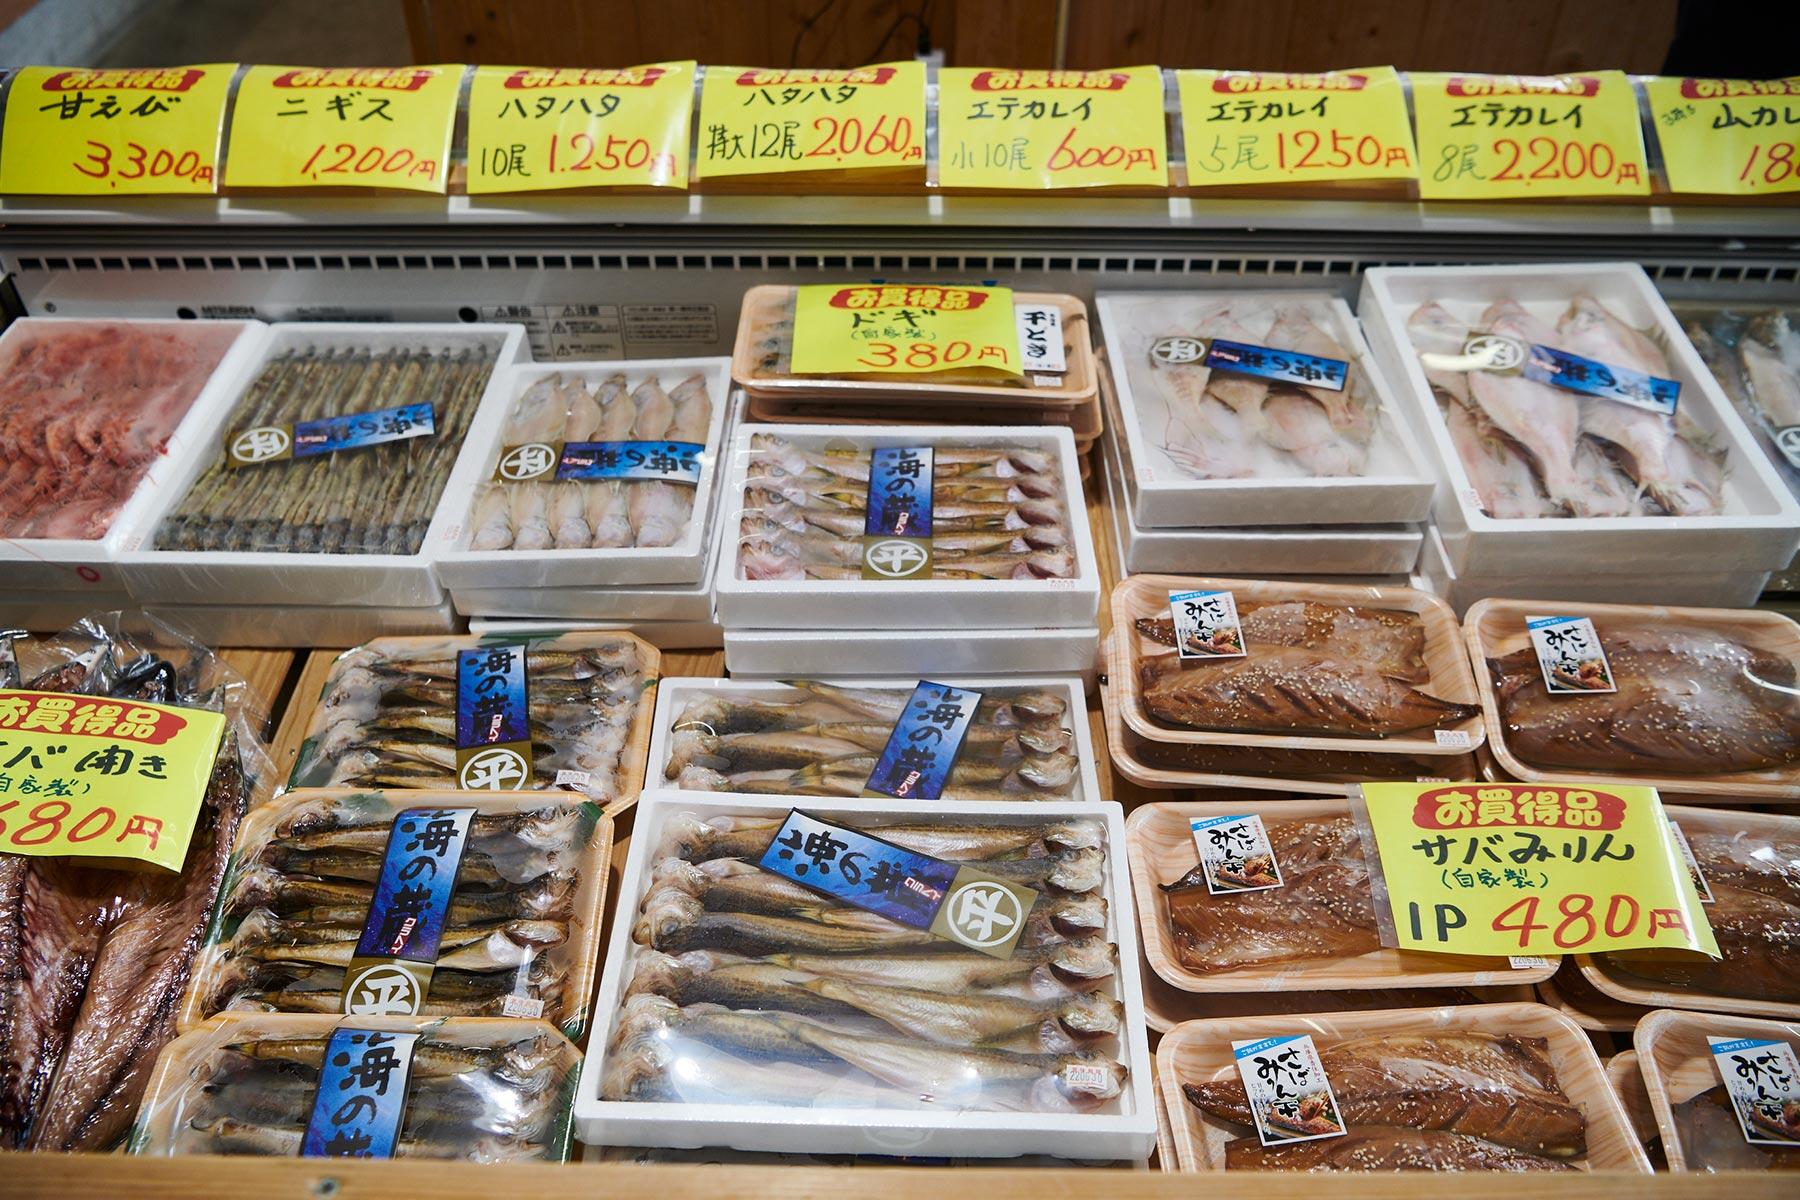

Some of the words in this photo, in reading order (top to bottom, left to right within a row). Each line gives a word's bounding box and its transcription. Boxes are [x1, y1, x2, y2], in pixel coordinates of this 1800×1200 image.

[40, 92, 181, 120] 甘えび
[277, 91, 393, 121] ニギス
[498, 94, 620, 119] ハタハタ
[743, 85, 858, 106] ハタハタ
[967, 97, 1093, 121] エテカレイ
[1206, 96, 1329, 122] エテカレイ
[1450, 103, 1583, 128] エテカレイ
[481, 144, 532, 177] 10尾
[1047, 127, 1157, 171] 600円
[1199, 134, 1269, 172] 5尾
[1433, 144, 1487, 182] 8尾
[846, 288, 970, 310] お買得品
[852, 309, 937, 328] ドギ
[856, 341, 1008, 369] 380円
[0, 741, 167, 780] バ開き
[1434, 789, 1603, 827] お買得品
[1412, 831, 1635, 866] サバみりん
[1441, 868, 1550, 889] (自家製)
[1491, 893, 1692, 949] 480円
[1278, 1047, 1310, 1087] さば
[1756, 1051, 1792, 1092] さば
